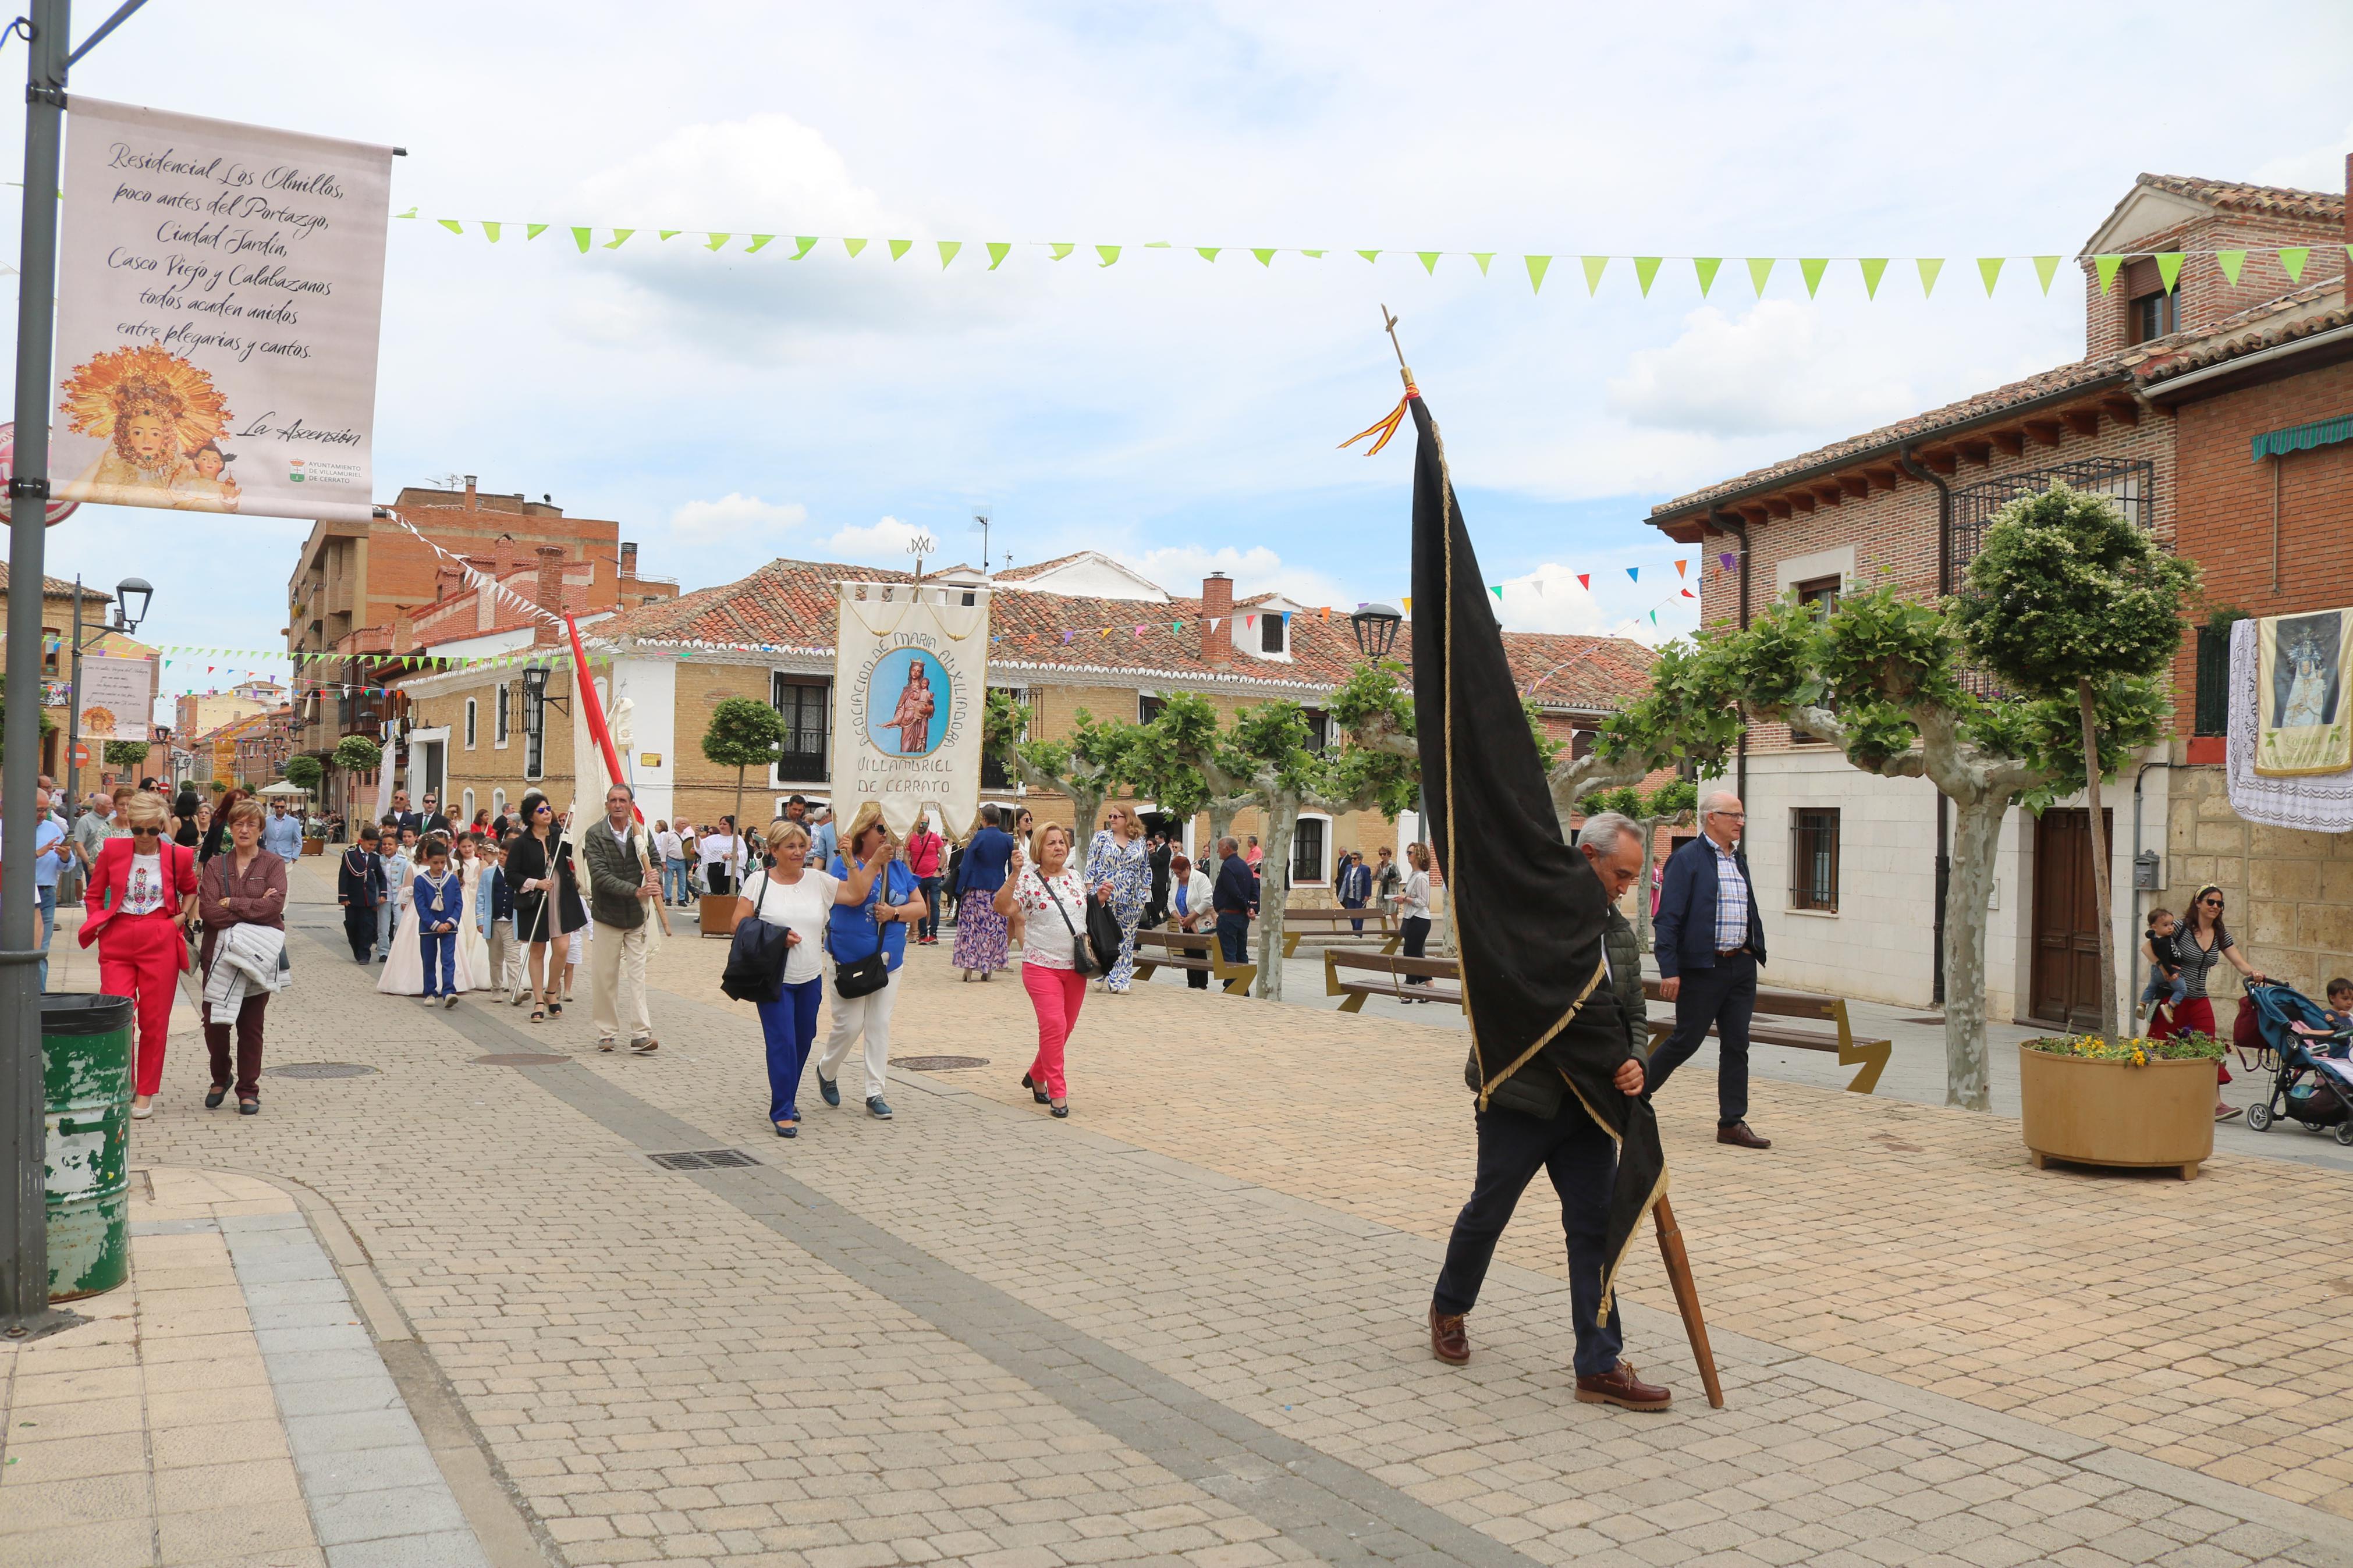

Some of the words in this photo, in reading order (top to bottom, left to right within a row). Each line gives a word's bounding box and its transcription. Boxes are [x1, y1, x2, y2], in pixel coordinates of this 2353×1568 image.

[107, 142, 223, 179] Residencial
[216, 163, 255, 187] Los
[262, 165, 344, 200] Olmillos,
[112, 182, 152, 204] poco
[156, 191, 202, 212] antes
[206, 190, 244, 216] del
[239, 197, 329, 240] Portazgo,
[157, 220, 229, 250] Ciudad
[224, 229, 287, 258] Jardín,
[108, 246, 158, 271] Casco
[165, 253, 208, 292] Viejo
[204, 270, 224, 292] y
[228, 264, 332, 296] Calabazanos
[139, 284, 183, 310] todos
[187, 292, 243, 318] acuden
[247, 299, 299, 325] unidos
[116, 319, 161, 339] entre
[162, 321, 242, 357] plegarias
[237, 340, 257, 362] y
[260, 339, 311, 359] cantos.
[236, 410, 276, 437] La
[276, 418, 362, 447] Ascensión
[308, 461, 361, 471] AYUNTAMIENTO
[319, 469, 363, 478] VILLAMURIEL
[320, 476, 350, 484] CERRATO
[851, 660, 874, 746] ASOCIACION
[872, 639, 889, 659] DE
[894, 632, 936, 649] MARIA
[938, 649, 968, 748] AUXILIADORA
[857, 756, 953, 772] VILLAMURIEL
[857, 779, 877, 792] DE
[886, 779, 950, 793] CERRATO
